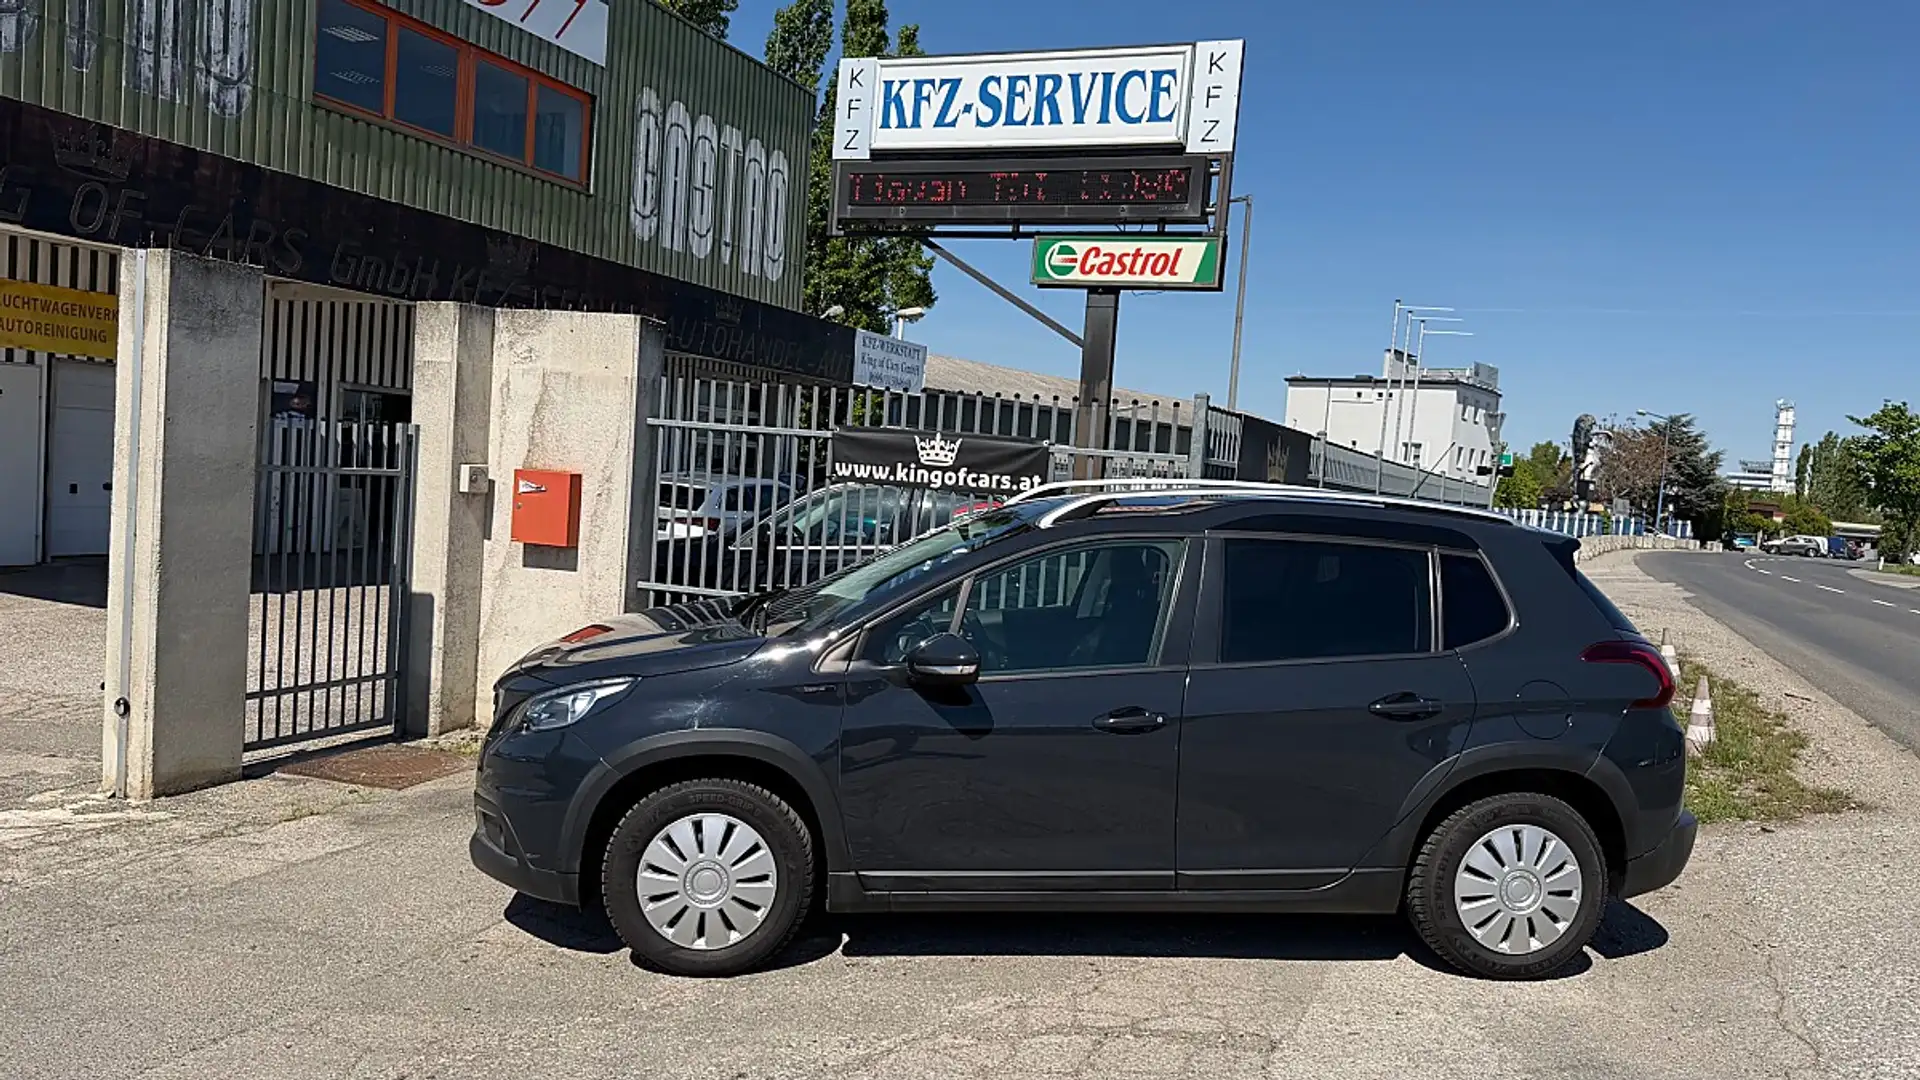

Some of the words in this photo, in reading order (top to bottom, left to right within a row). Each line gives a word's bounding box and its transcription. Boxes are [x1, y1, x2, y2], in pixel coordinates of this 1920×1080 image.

[844, 68, 866, 151] KFZ
[880, 69, 1178, 130] KFZ-SERVICE
[1200, 51, 1229, 143] KFZ
[69, 180, 149, 240] OF
[171, 203, 309, 273] CARS
[1079, 245, 1183, 277] Castrol
[0, 293, 119, 322] UCHTWAGENVERK
[834, 461, 1042, 491] www.kingofcars.at
